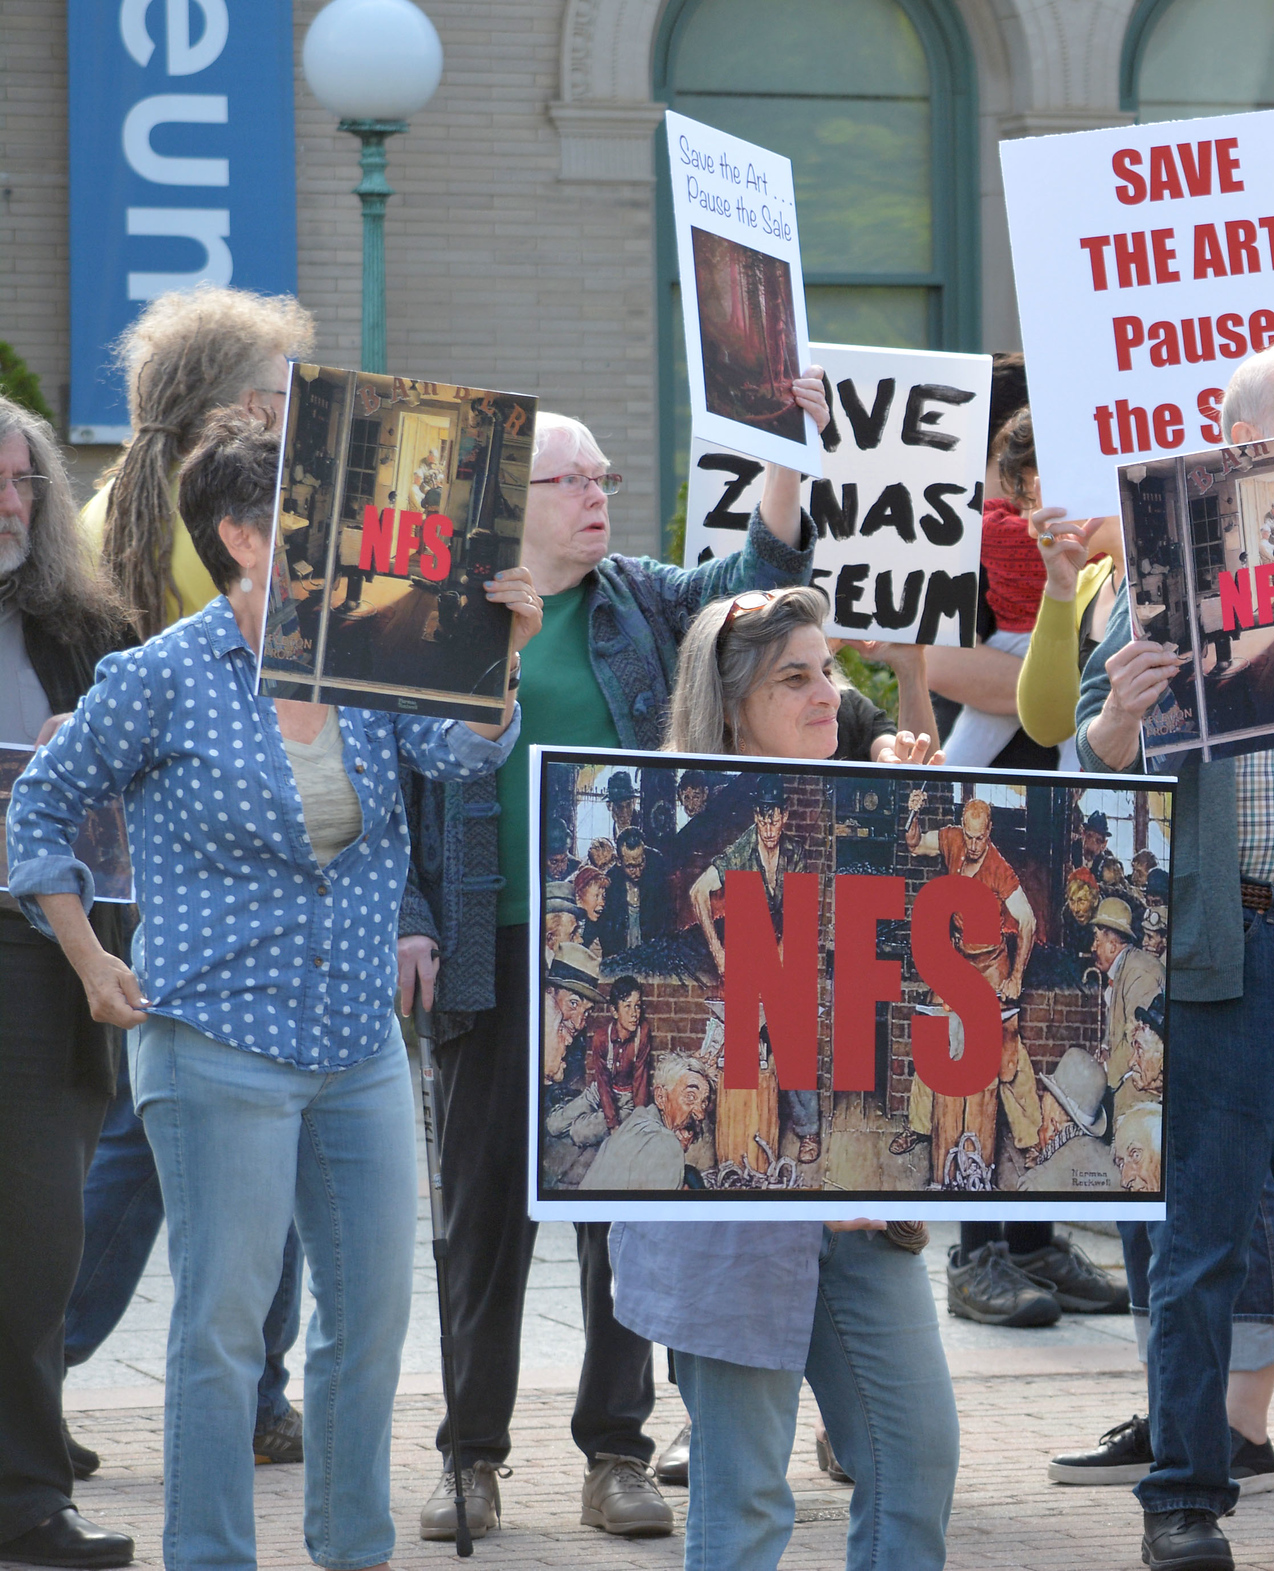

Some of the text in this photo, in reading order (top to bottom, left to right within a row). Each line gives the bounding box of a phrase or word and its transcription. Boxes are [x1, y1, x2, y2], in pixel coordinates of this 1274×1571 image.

[679, 134, 715, 174] Save
[720, 152, 741, 184] the
[746, 163, 768, 196] Art
[1111, 136, 1245, 206] SAVE
[686, 174, 792, 241] Pause the Sale
[1079, 228, 1181, 292] THE
[820, 369, 977, 453] VE
[1093, 398, 1186, 456] the
[697, 452, 984, 547] ZNAS'
[358, 504, 452, 582] NFS
[724, 870, 1002, 1098] NFS
